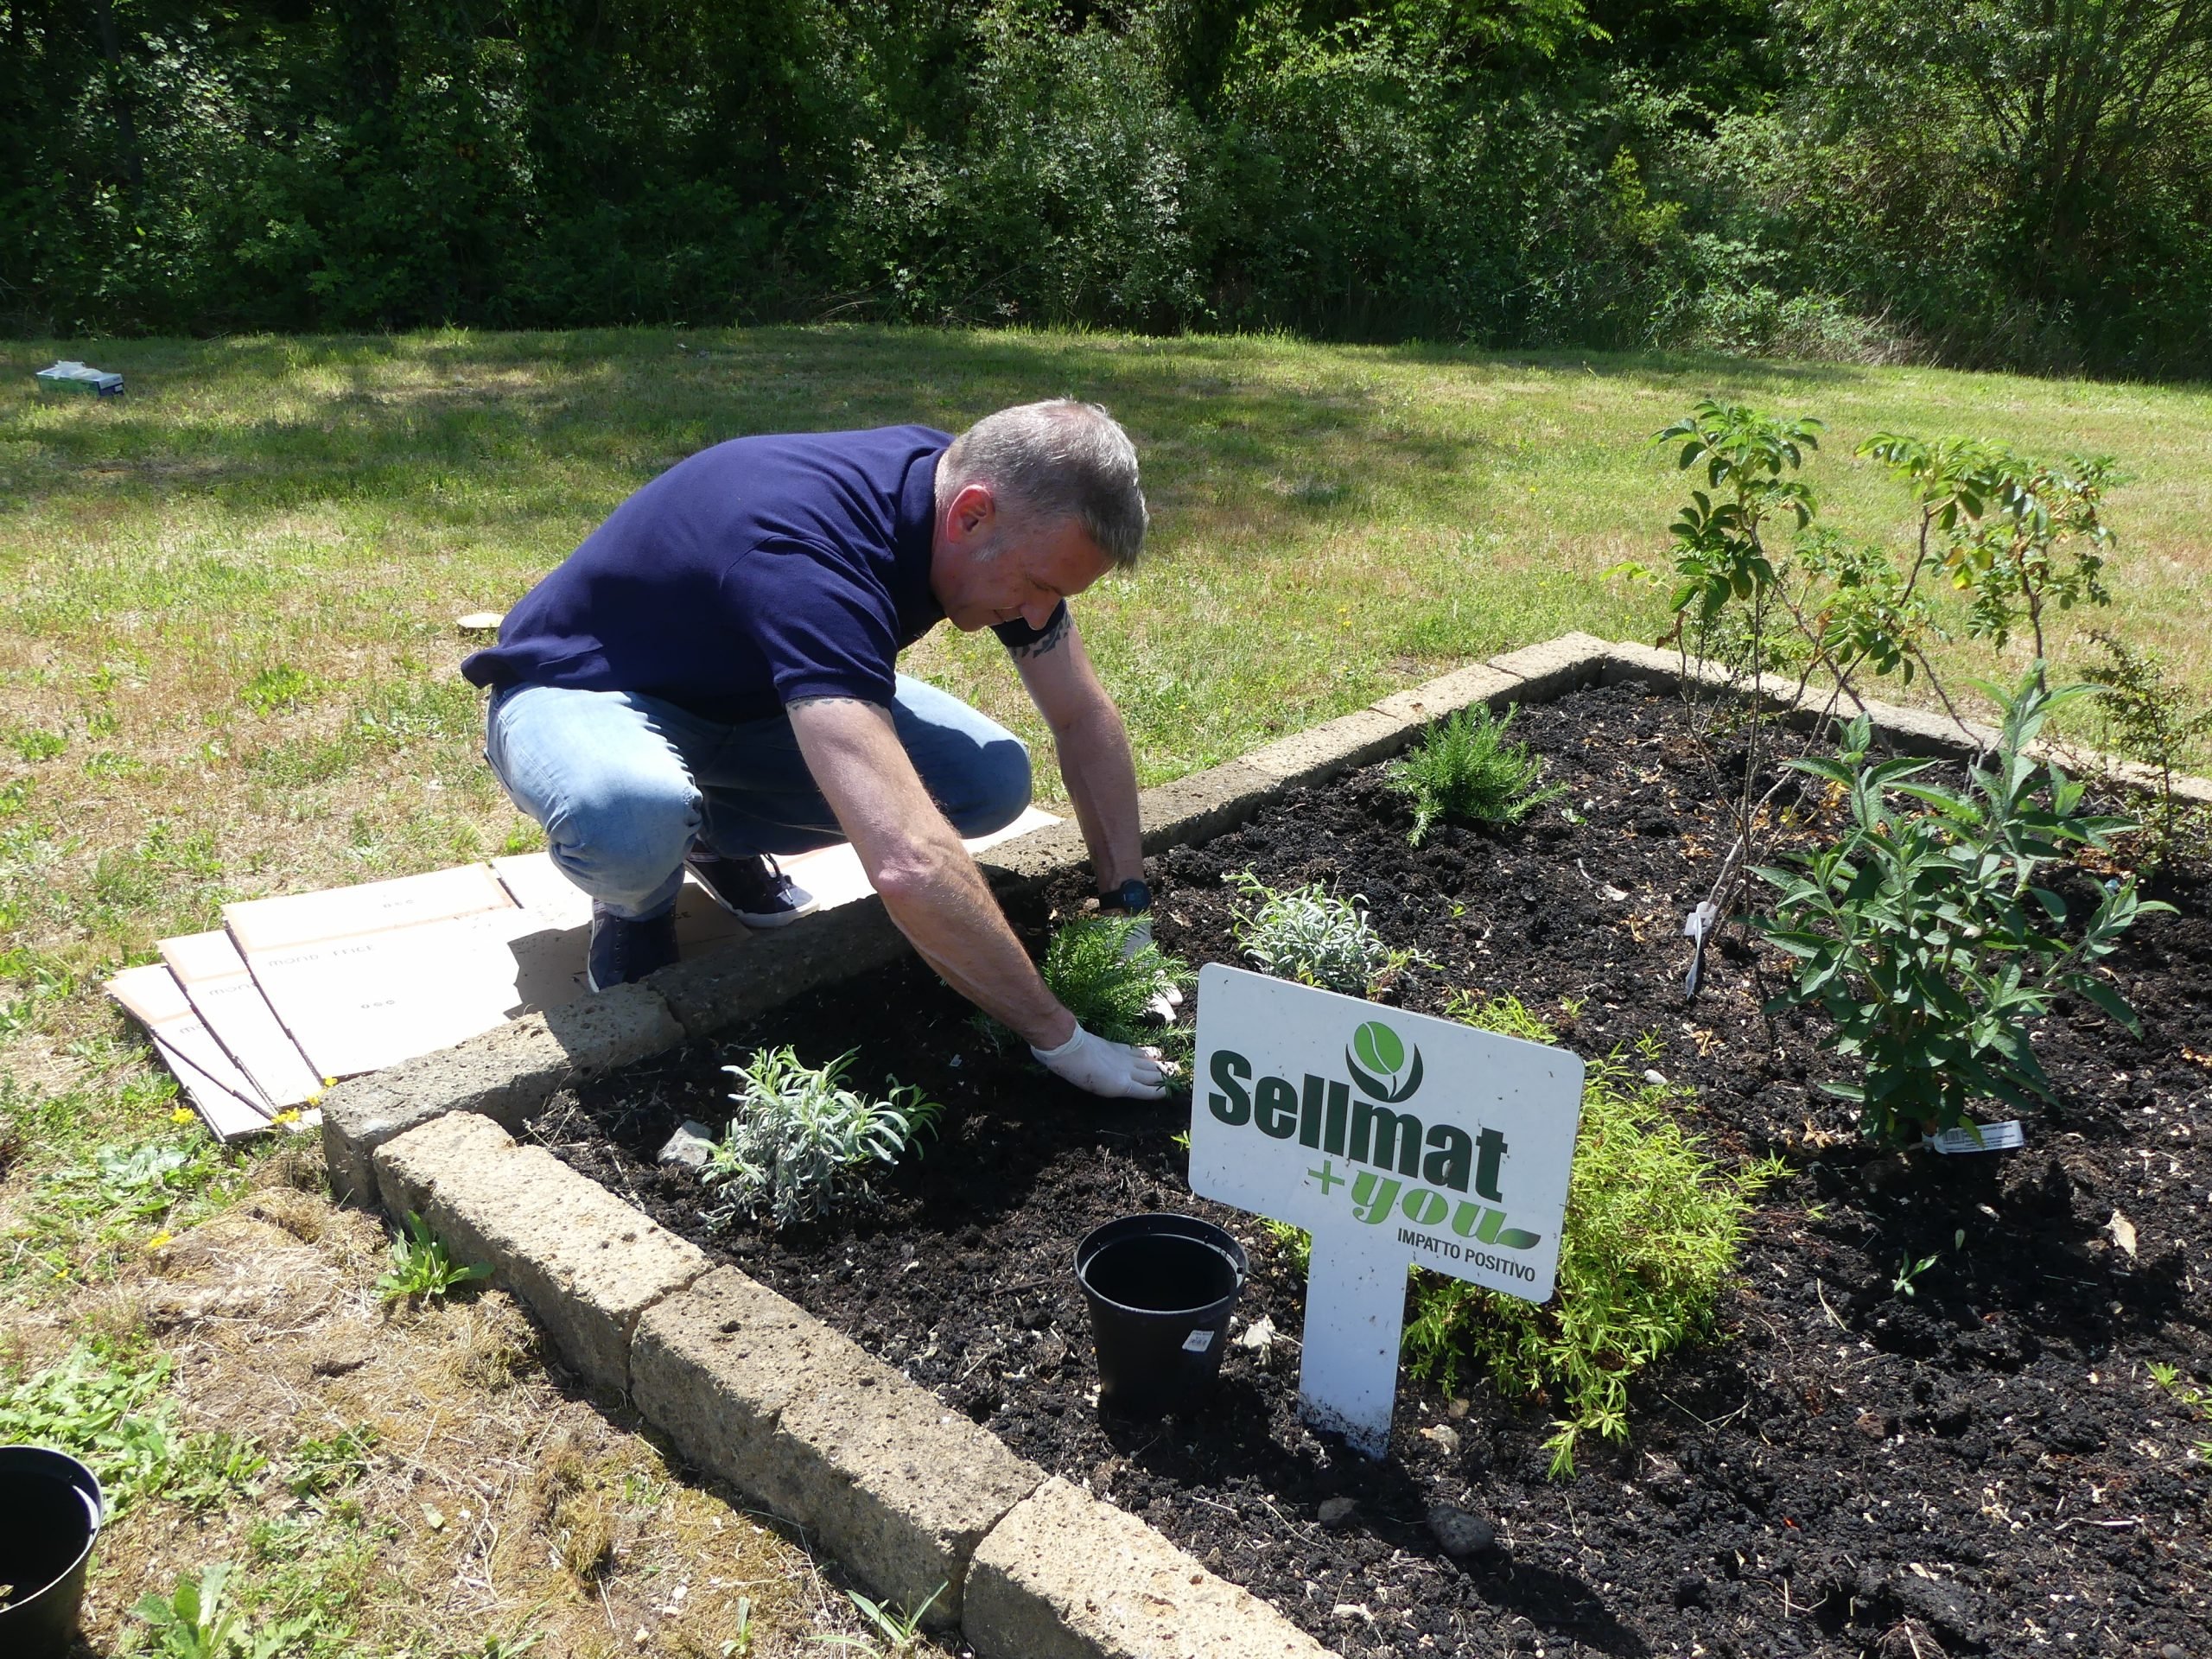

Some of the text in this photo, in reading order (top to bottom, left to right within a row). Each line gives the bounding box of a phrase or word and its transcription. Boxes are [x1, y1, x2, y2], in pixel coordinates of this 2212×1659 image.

[1208, 1049, 1509, 1204] Sellmat
[1397, 1227, 1535, 1283] IMPATTO POSITIVO
